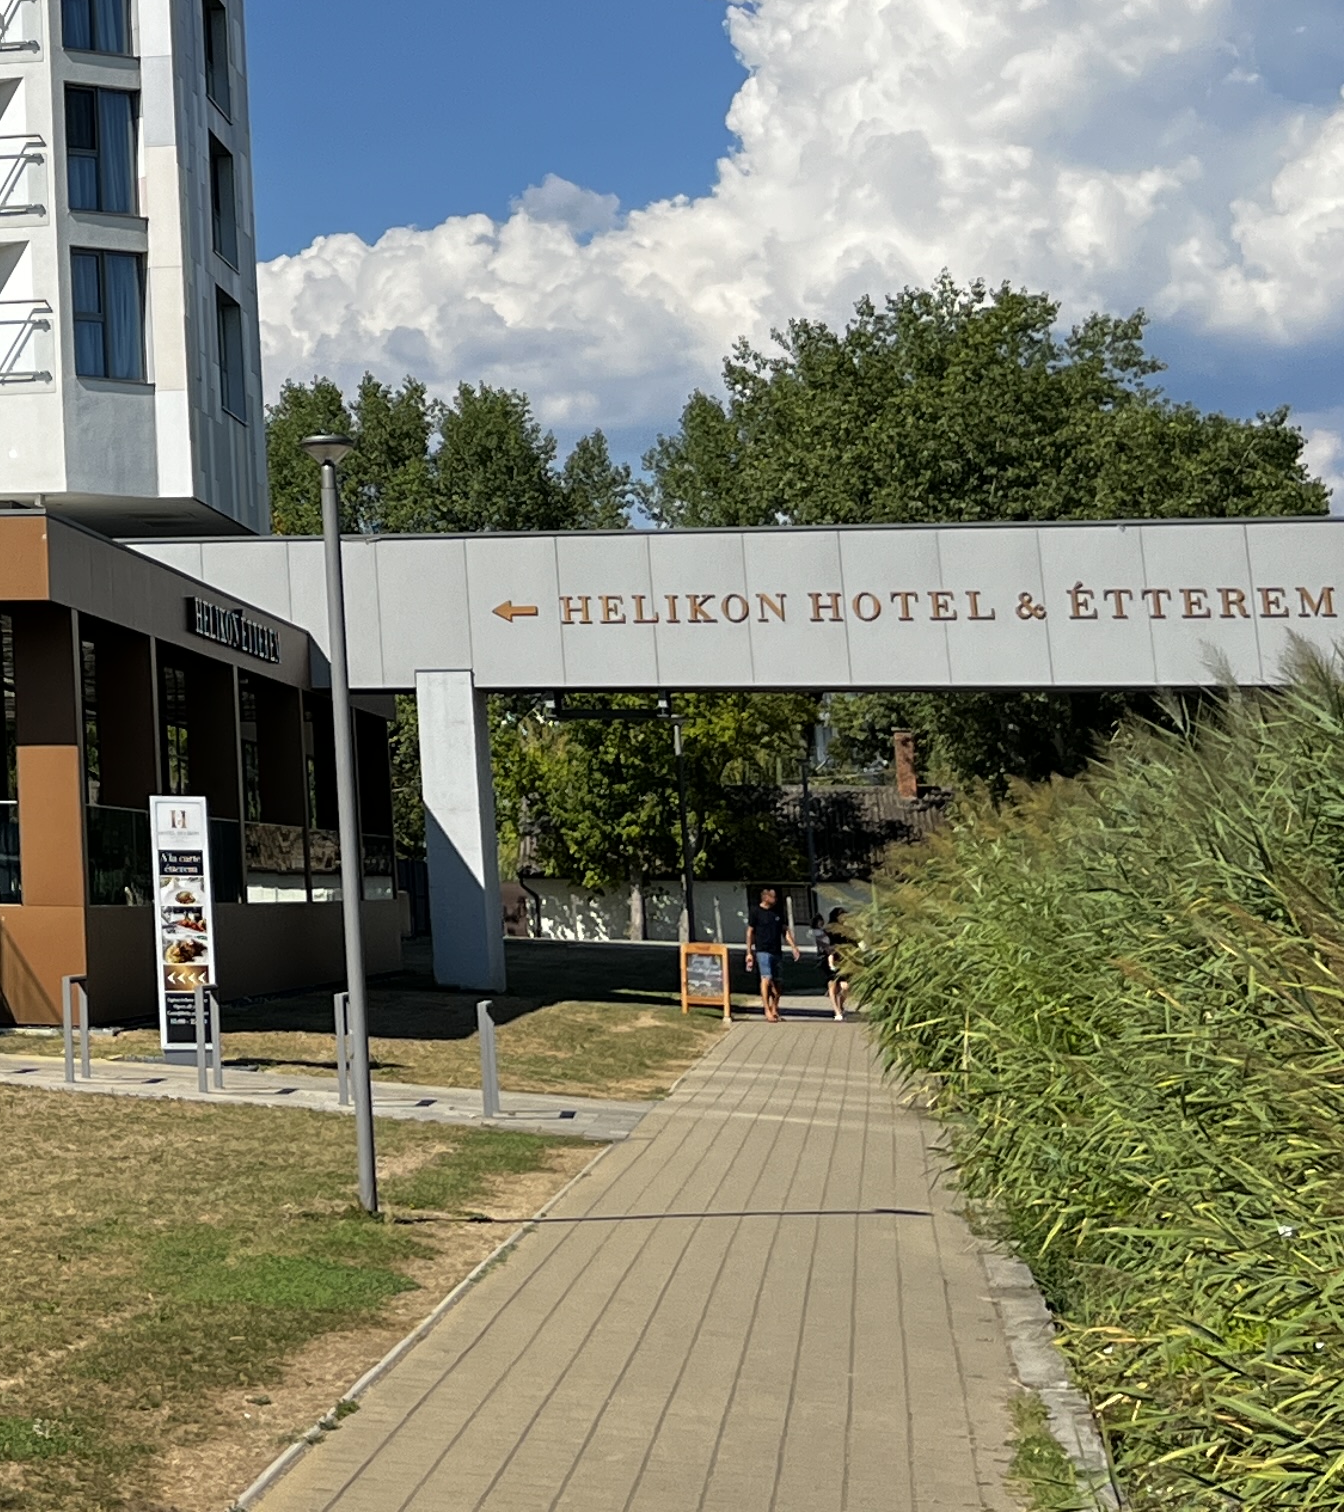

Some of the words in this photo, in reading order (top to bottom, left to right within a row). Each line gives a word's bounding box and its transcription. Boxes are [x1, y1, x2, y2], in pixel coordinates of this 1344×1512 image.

[195, 597, 239, 647] HELIKON
[558, 591, 788, 625] HELIKON
[807, 590, 996, 623] HOTEL
[1014, 592, 1048, 621] &
[1065, 581, 1338, 620] ÉTTEREM
